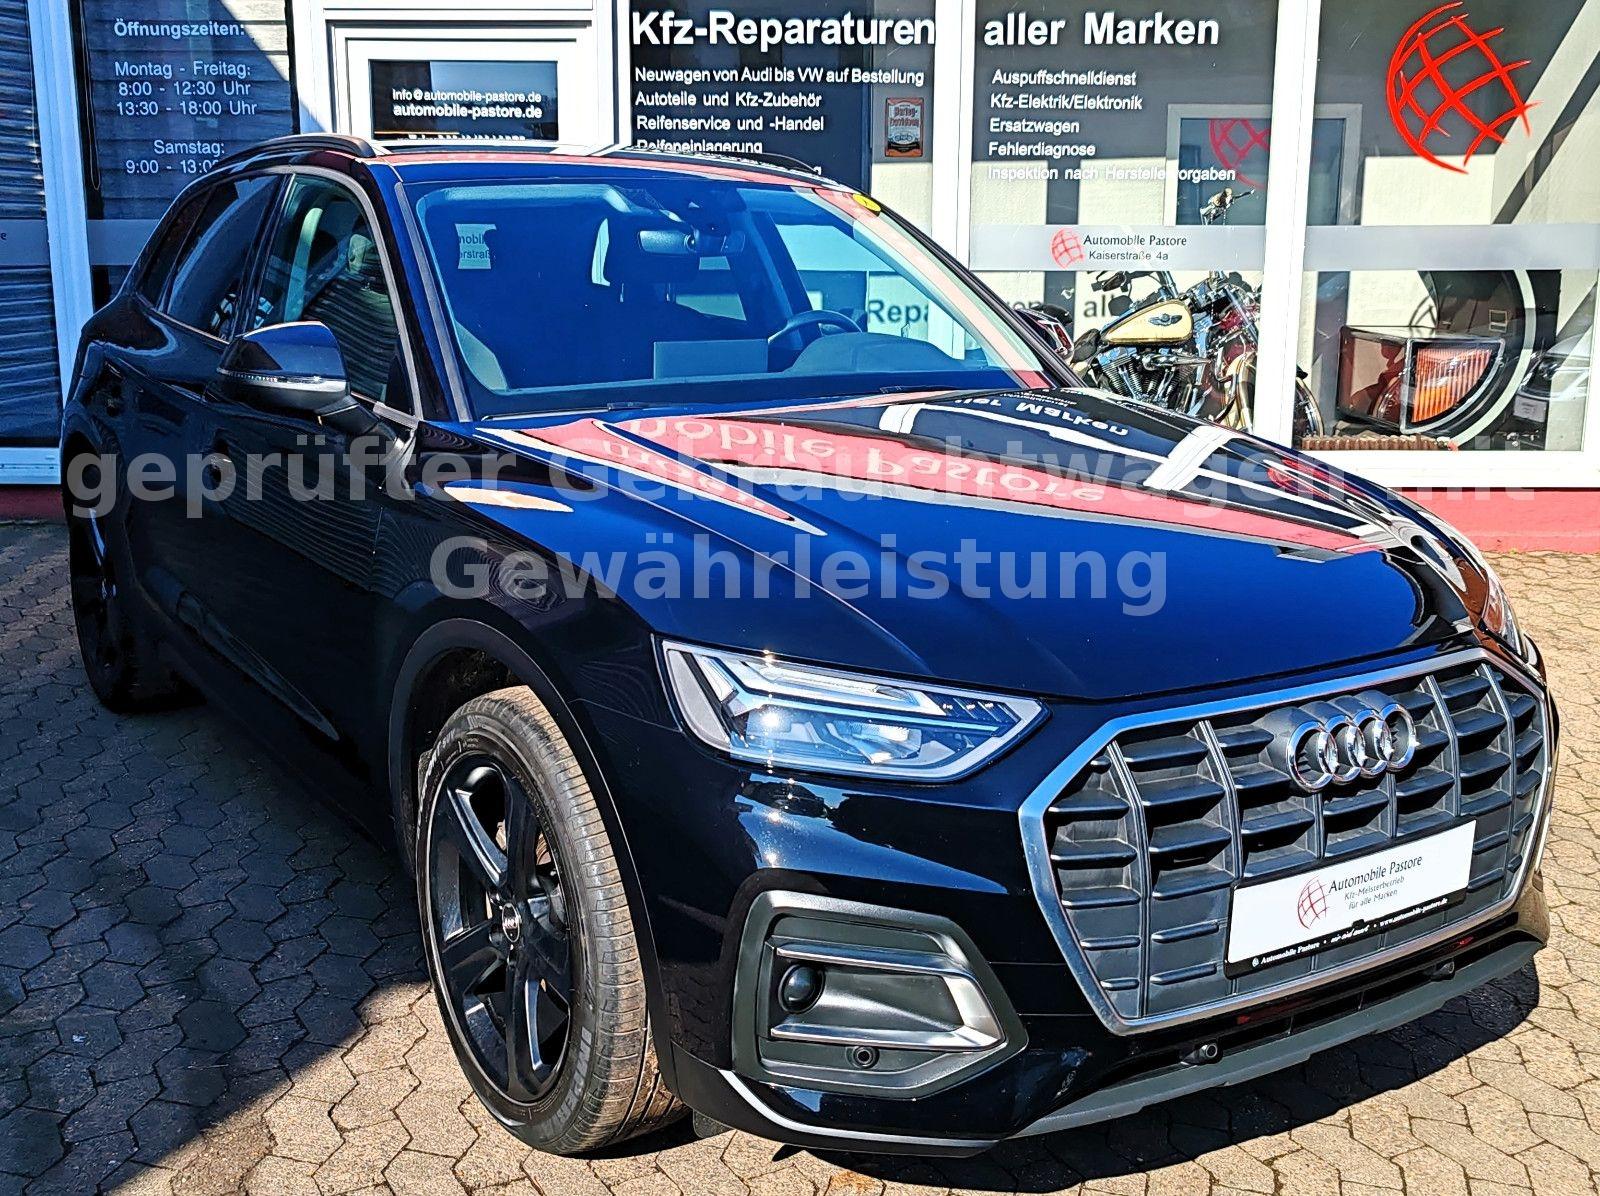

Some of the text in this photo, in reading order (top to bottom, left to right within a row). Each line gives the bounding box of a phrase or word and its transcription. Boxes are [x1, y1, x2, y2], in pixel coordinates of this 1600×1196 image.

[114, 19, 245, 39] Öffnungszeiten:
[632, 10, 936, 52] Kfz-Reparaturen
[984, 12, 1219, 46] aller Marken
[115, 62, 173, 79] Montag
[193, 61, 250, 78] Freitag:
[635, 67, 924, 86] Neuwagen von Audi bis VW auf Bestellung
[992, 69, 1137, 88] Auspuffschnelldienst
[118, 82, 152, 96] 8:00
[173, 82, 216, 96] 12:30
[223, 81, 251, 96] Uhr
[117, 101, 159, 115] 13:30
[180, 101, 222, 115] 18:00
[229, 101, 257, 115] Uhr
[635, 91, 822, 108] Autoteile und Kfz-Zubehör
[990, 94, 1143, 111] Kfz-Elektrik/Elektronik
[393, 103, 542, 120] automobile-pastore.de
[636, 115, 824, 131] Reifenservice und -Handel
[990, 118, 1080, 136] Ersatzwagen
[153, 140, 225, 157] Samstag:
[989, 142, 1097, 158] Fehlerdiagnose
[126, 160, 158, 174] 9:00
[180, 160, 218, 174] 13:0
[988, 165, 1058, 181] Inspektion
[1064, 165, 1098, 181] nach
[1083, 234, 1187, 246] Automobile Pastore
[1089, 250, 1169, 261] Kaiserstraße 4a
[1328, 856, 1423, 894] Automobile Pastore
